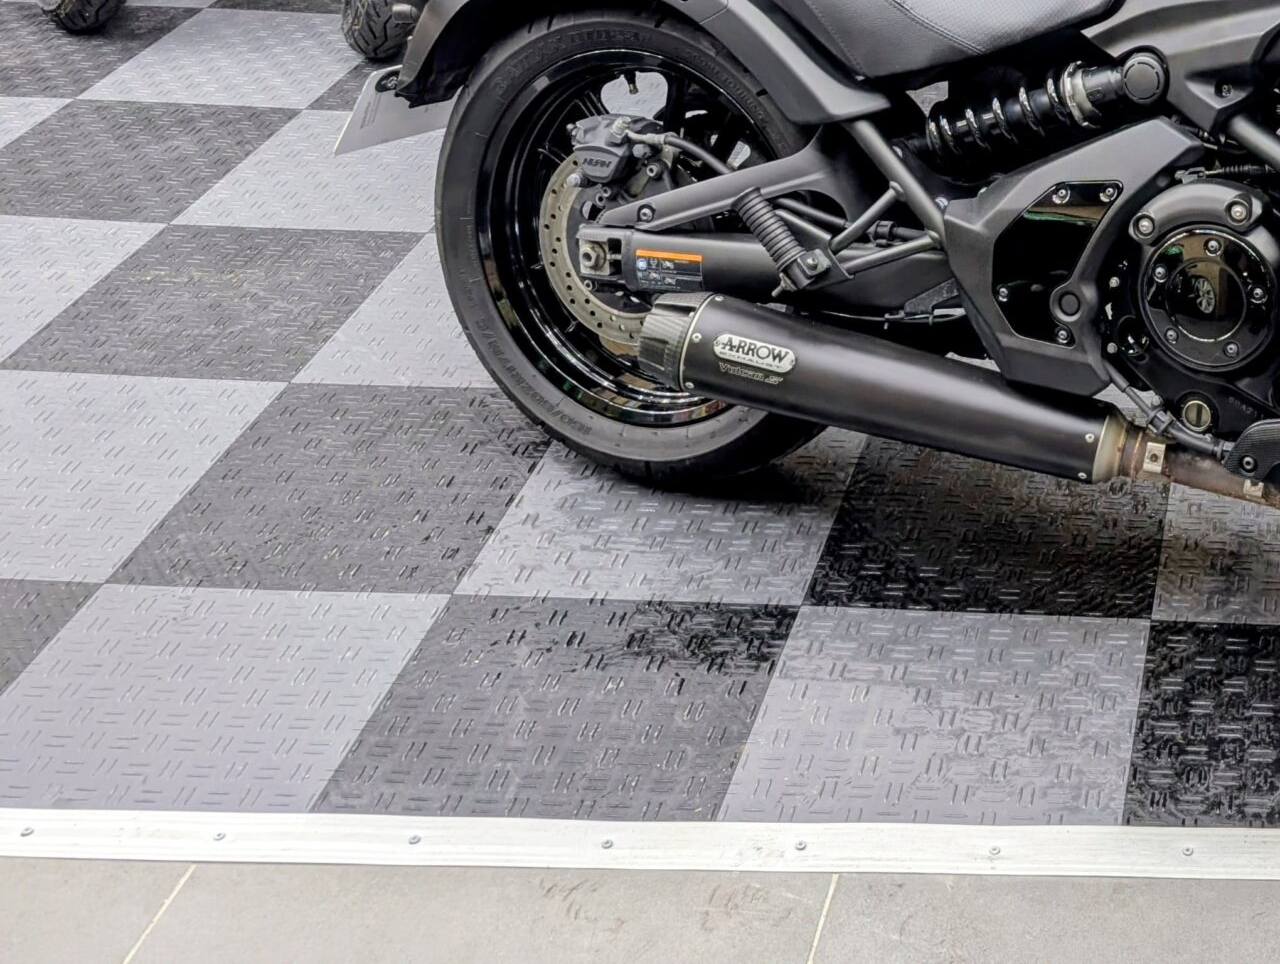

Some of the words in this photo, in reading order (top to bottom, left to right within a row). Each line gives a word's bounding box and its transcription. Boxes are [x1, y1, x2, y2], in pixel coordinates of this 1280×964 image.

[720, 337, 789, 362] ARROW
[718, 350, 783, 371] EXHAUST
[718, 362, 763, 382] Vulcan
